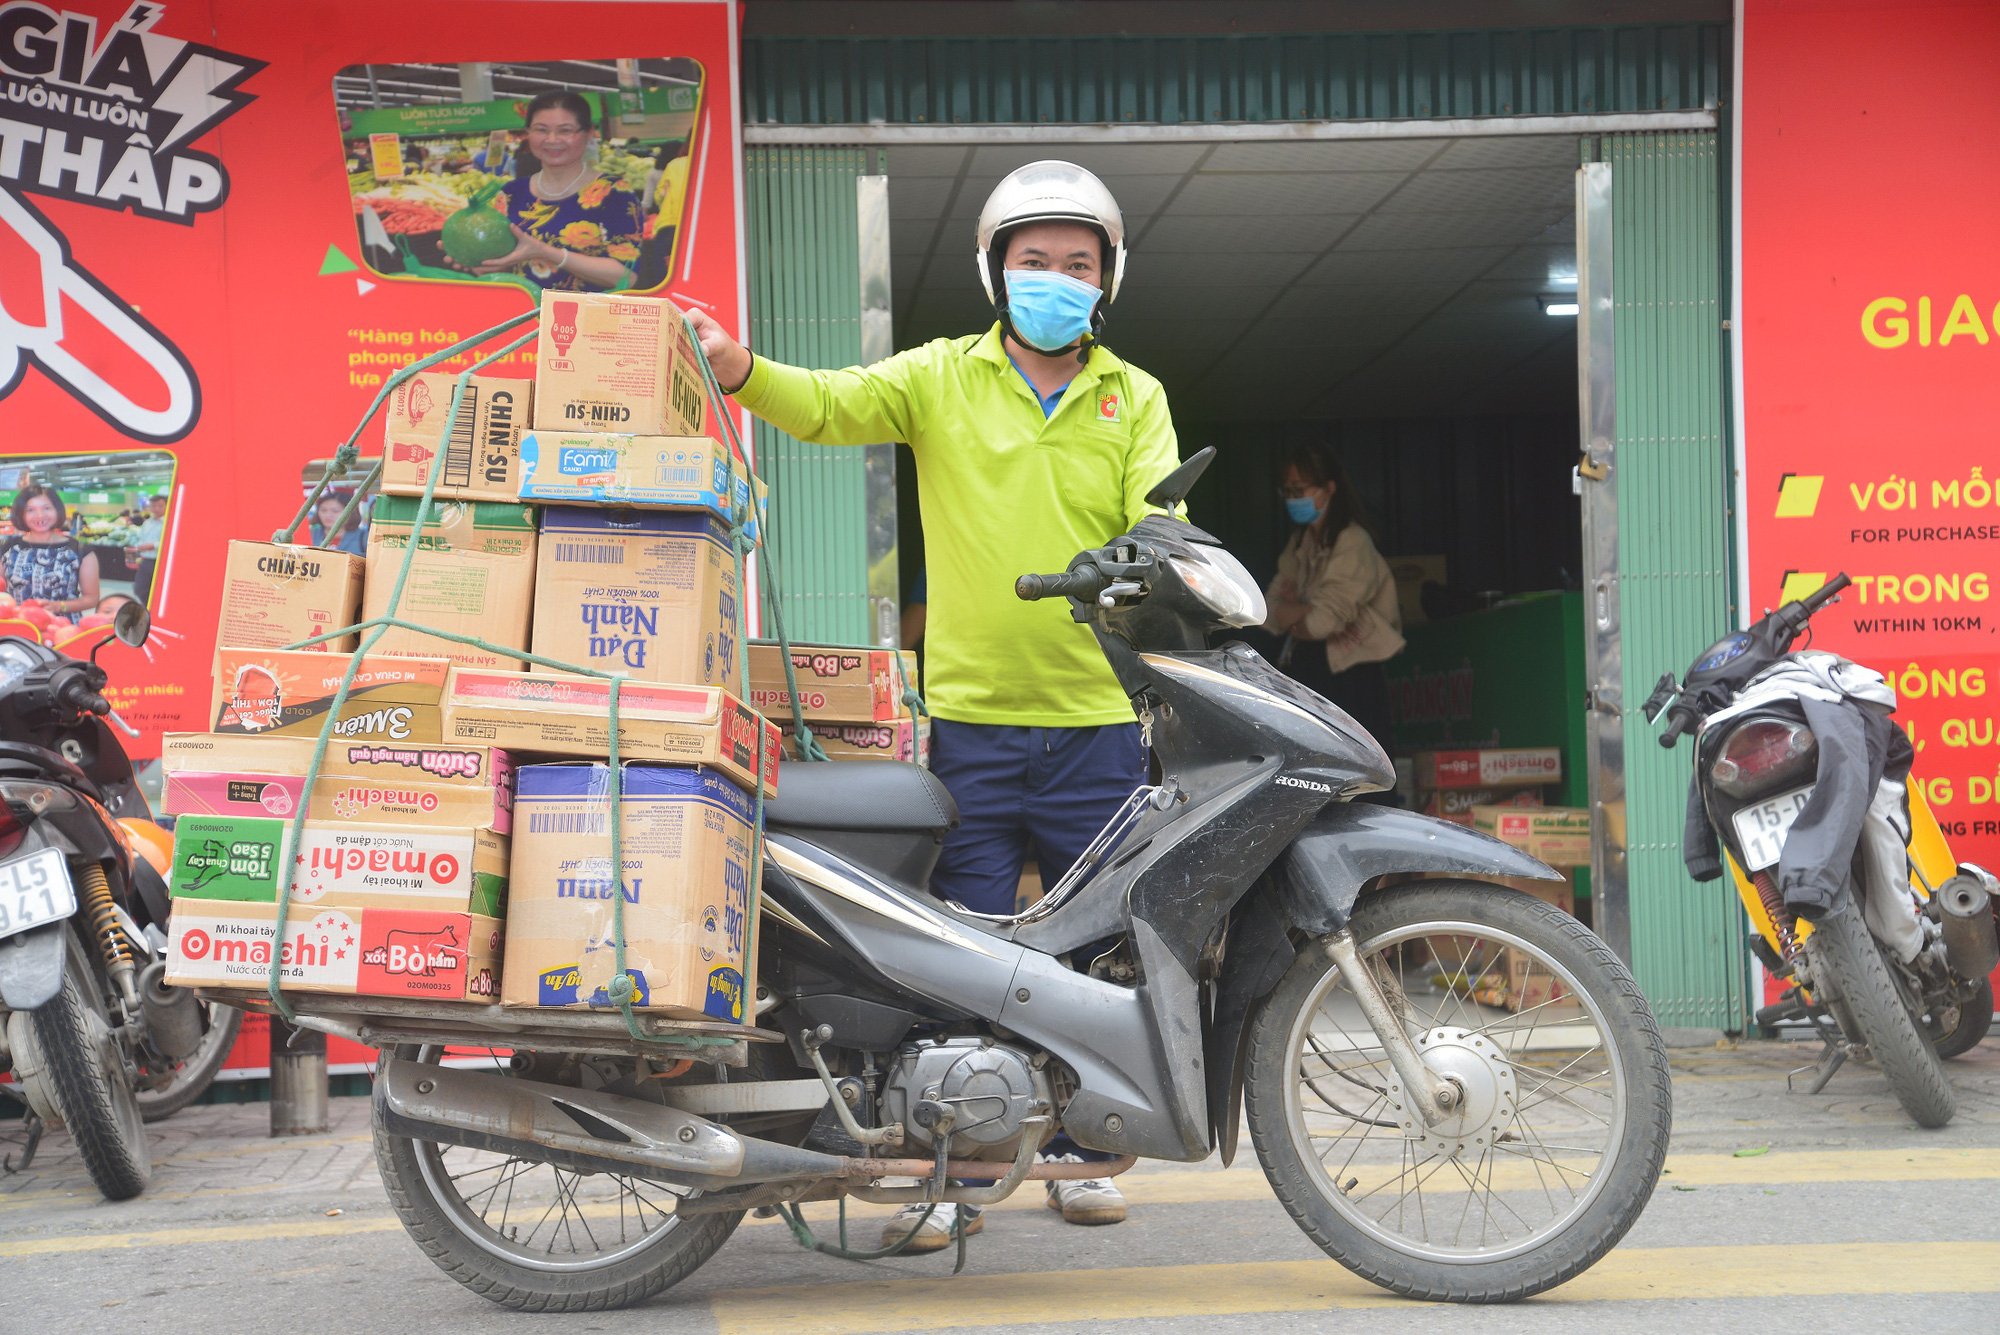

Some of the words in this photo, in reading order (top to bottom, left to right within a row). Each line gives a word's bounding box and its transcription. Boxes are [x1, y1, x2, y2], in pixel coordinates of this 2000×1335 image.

[0, 4, 152, 96] GIÁ
[73, 97, 149, 131] LUÔN
[1861, 294, 2000, 349] GIA
[420, 328, 459, 342] hóa
[560, 325, 575, 334] 500
[349, 349, 416, 367] phong
[350, 370, 380, 389] lựa
[565, 403, 630, 421] CHIN-SU
[485, 391, 513, 483] CHIN-SU
[1850, 474, 1917, 512] VỚI
[1851, 529, 1890, 544] FOR
[257, 556, 320, 578] CHIN-SU
[583, 588, 605, 599] CHẤT
[640, 590, 660, 599] 100%
[1853, 572, 1990, 604] TRONG
[581, 603, 660, 636] Nành
[1854, 619, 1925, 634] WITHIN
[1933, 617, 1981, 632] 10KM
[477, 657, 496, 666] SẢN
[813, 656, 838, 675] Bò
[843, 657, 858, 670] xốt
[323, 676, 343, 689] HÁI
[375, 672, 401, 681] CHUA
[405, 671, 415, 681] MÌ
[122, 685, 140, 696] có
[231, 698, 251, 708] THỊT
[258, 698, 279, 710] TÔM
[239, 710, 254, 721] Cốt
[256, 704, 277, 718] Nước
[285, 706, 312, 717] GOLD
[843, 727, 891, 747] Sườn
[349, 747, 371, 763] quả
[371, 748, 394, 764] ngũ
[395, 750, 418, 767] hầm
[422, 751, 480, 778] Sườn
[1275, 775, 1331, 793] HONDA
[347, 787, 439, 813] Omachi
[380, 805, 391, 814] tây
[392, 806, 409, 815] khoai
[409, 807, 418, 815] Mì
[335, 835, 348, 845] đà
[349, 835, 372, 846] đậm
[373, 836, 388, 848] cốt
[392, 838, 414, 848] Nước
[233, 844, 258, 858] Sao
[262, 844, 271, 858] 5
[188, 854, 205, 867] Cay
[206, 857, 228, 868] Chua
[230, 859, 268, 877] Tôm
[311, 847, 459, 885] Omachi
[585, 860, 613, 872] GUYÊN
[622, 860, 643, 869] 100%
[363, 874, 379, 886] tây
[381, 877, 409, 888] khoai
[411, 879, 423, 889] Mì
[216, 925, 229, 934] Mì
[230, 925, 258, 935] khoai
[260, 927, 276, 938] tây
[181, 929, 329, 967] Omachi
[364, 948, 387, 964] xốt
[389, 945, 425, 972] Bò
[427, 951, 456, 968] hầm
[226, 964, 250, 975] Nước
[251, 964, 267, 976] cốt
[291, 967, 304, 977] đà
[407, 982, 451, 991] 02OM00325
